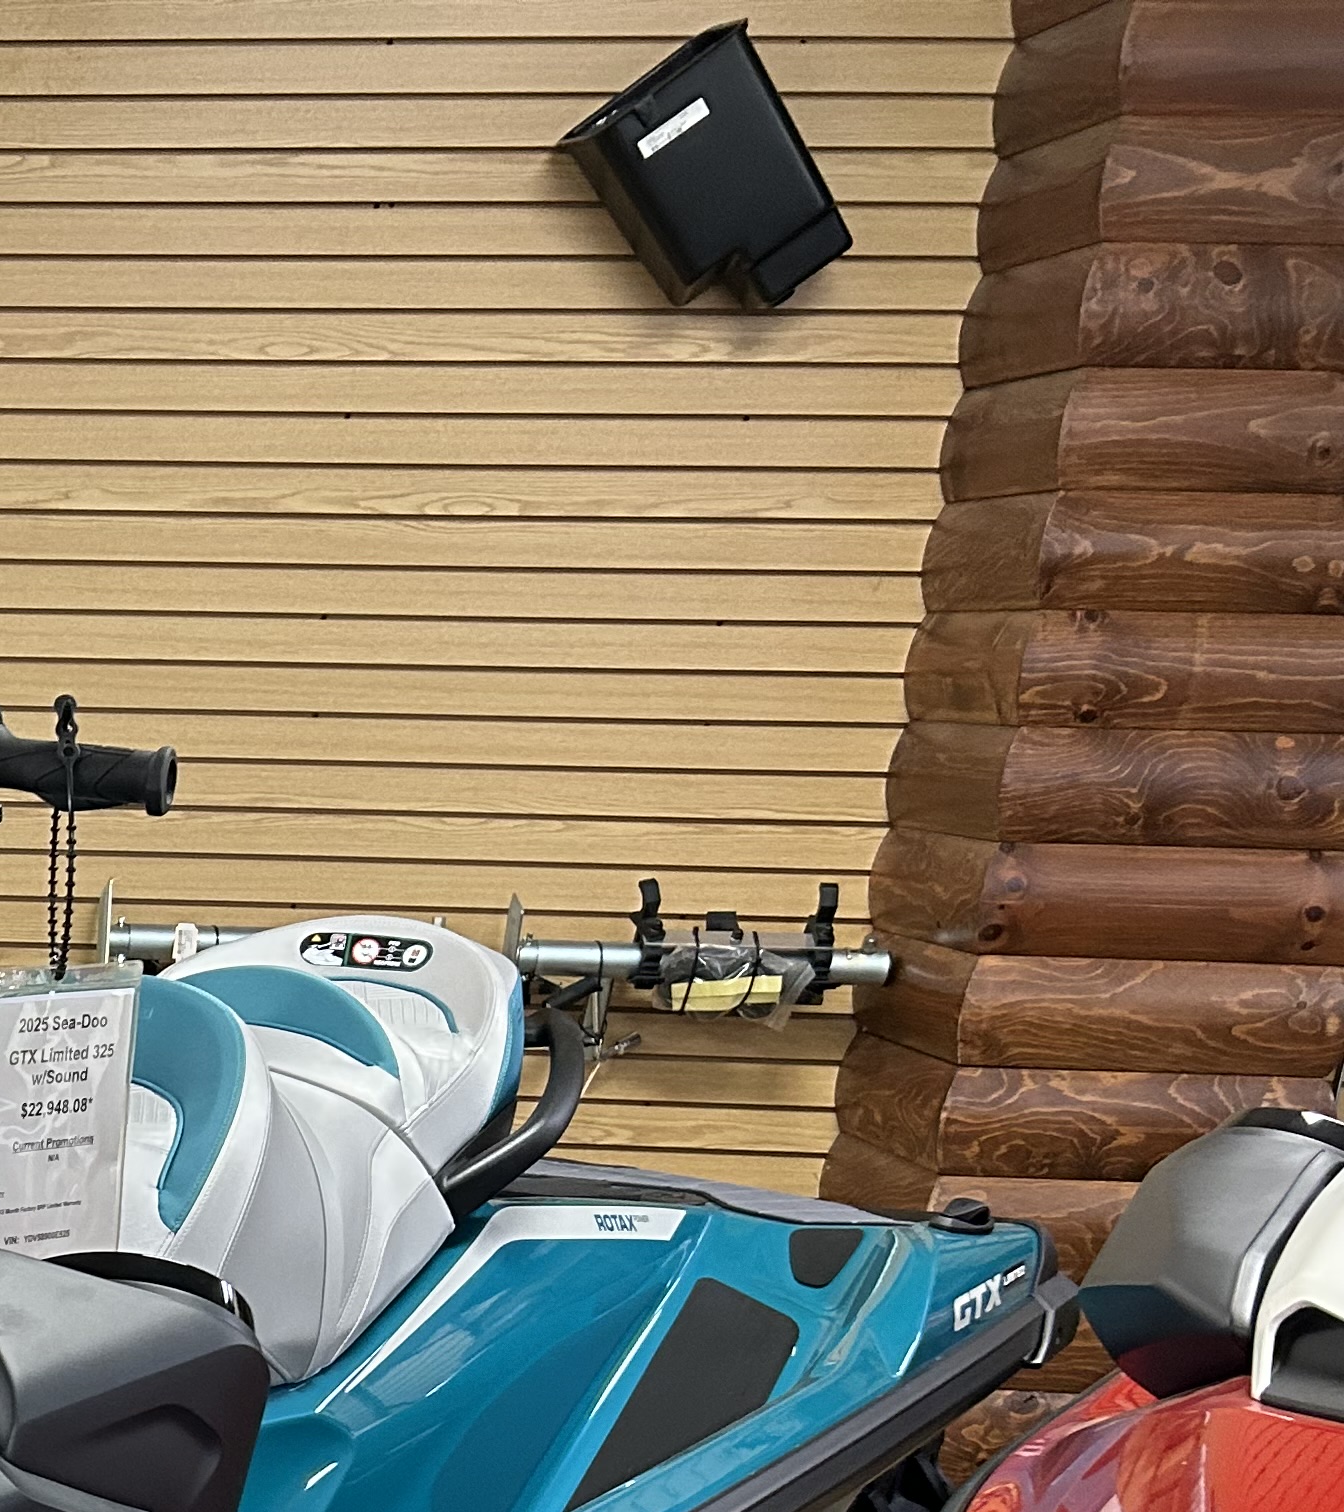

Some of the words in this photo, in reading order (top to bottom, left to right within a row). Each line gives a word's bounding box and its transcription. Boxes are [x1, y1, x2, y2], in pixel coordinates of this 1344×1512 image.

[18, 1016, 49, 1034] 2025
[52, 1013, 108, 1031] Sea-Doo
[9, 1049, 38, 1066] GTX
[41, 1045, 89, 1063] Limited
[92, 1043, 115, 1060] 325
[31, 1067, 89, 1085] w/Sound
[12, 1138, 45, 1153] Current
[46, 1135, 94, 1150] Promotions
[593, 1214, 638, 1232] ROTAX
[4, 1236, 19, 1245] VIN:
[953, 1273, 1002, 1332] GTX
